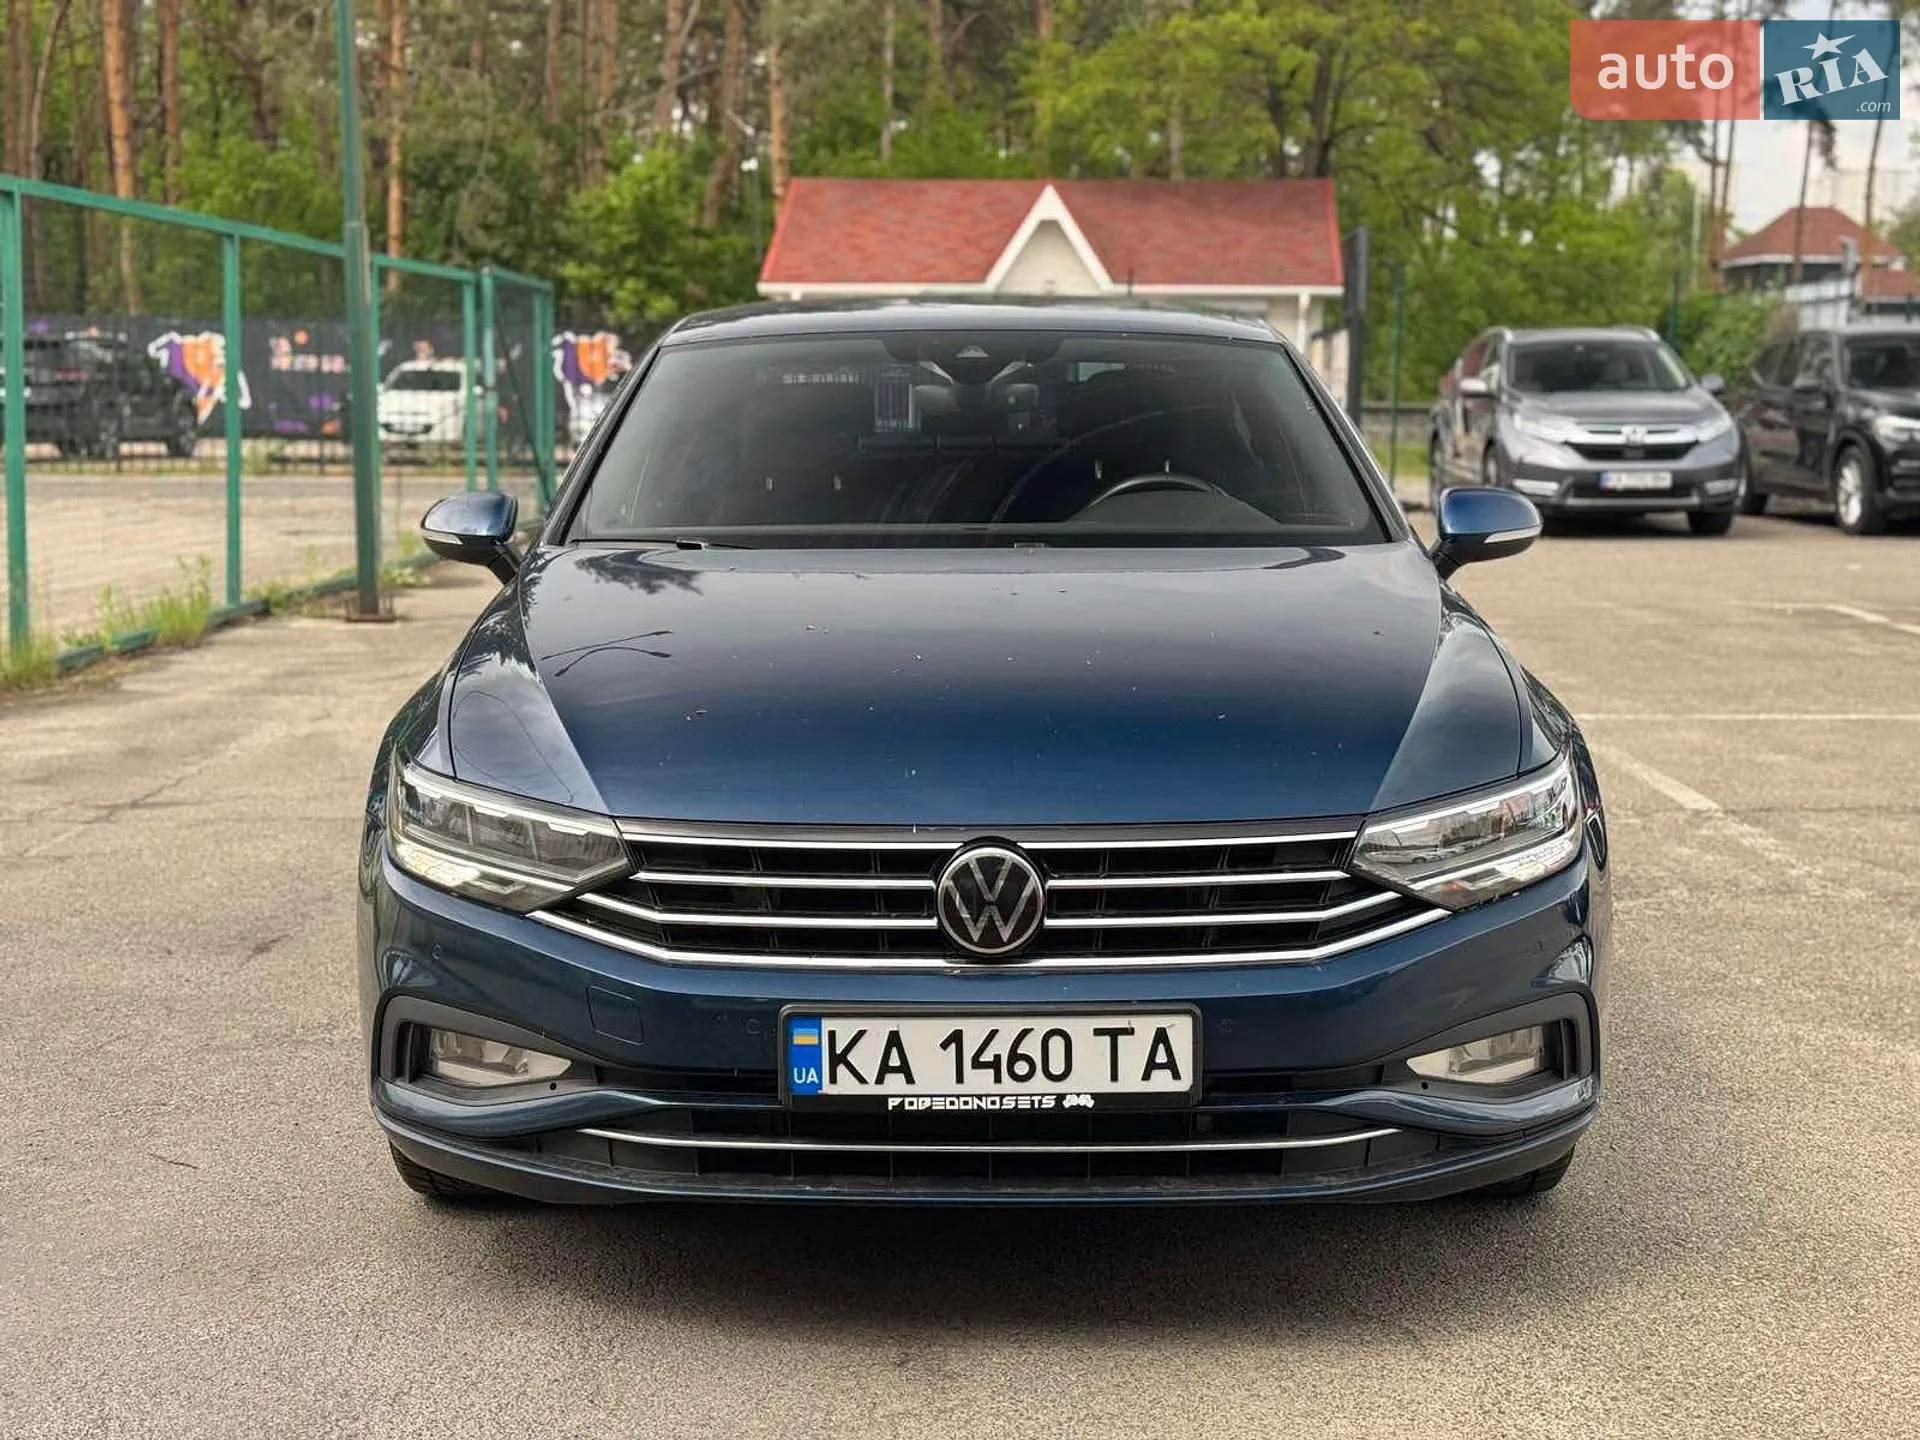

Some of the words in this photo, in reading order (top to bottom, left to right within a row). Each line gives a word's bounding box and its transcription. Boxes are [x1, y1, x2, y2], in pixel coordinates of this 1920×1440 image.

[827, 1028, 916, 1086] KA
[939, 1027, 1073, 1085] 1460
[1092, 1026, 1182, 1082] TA
[793, 1067, 819, 1084] UA
